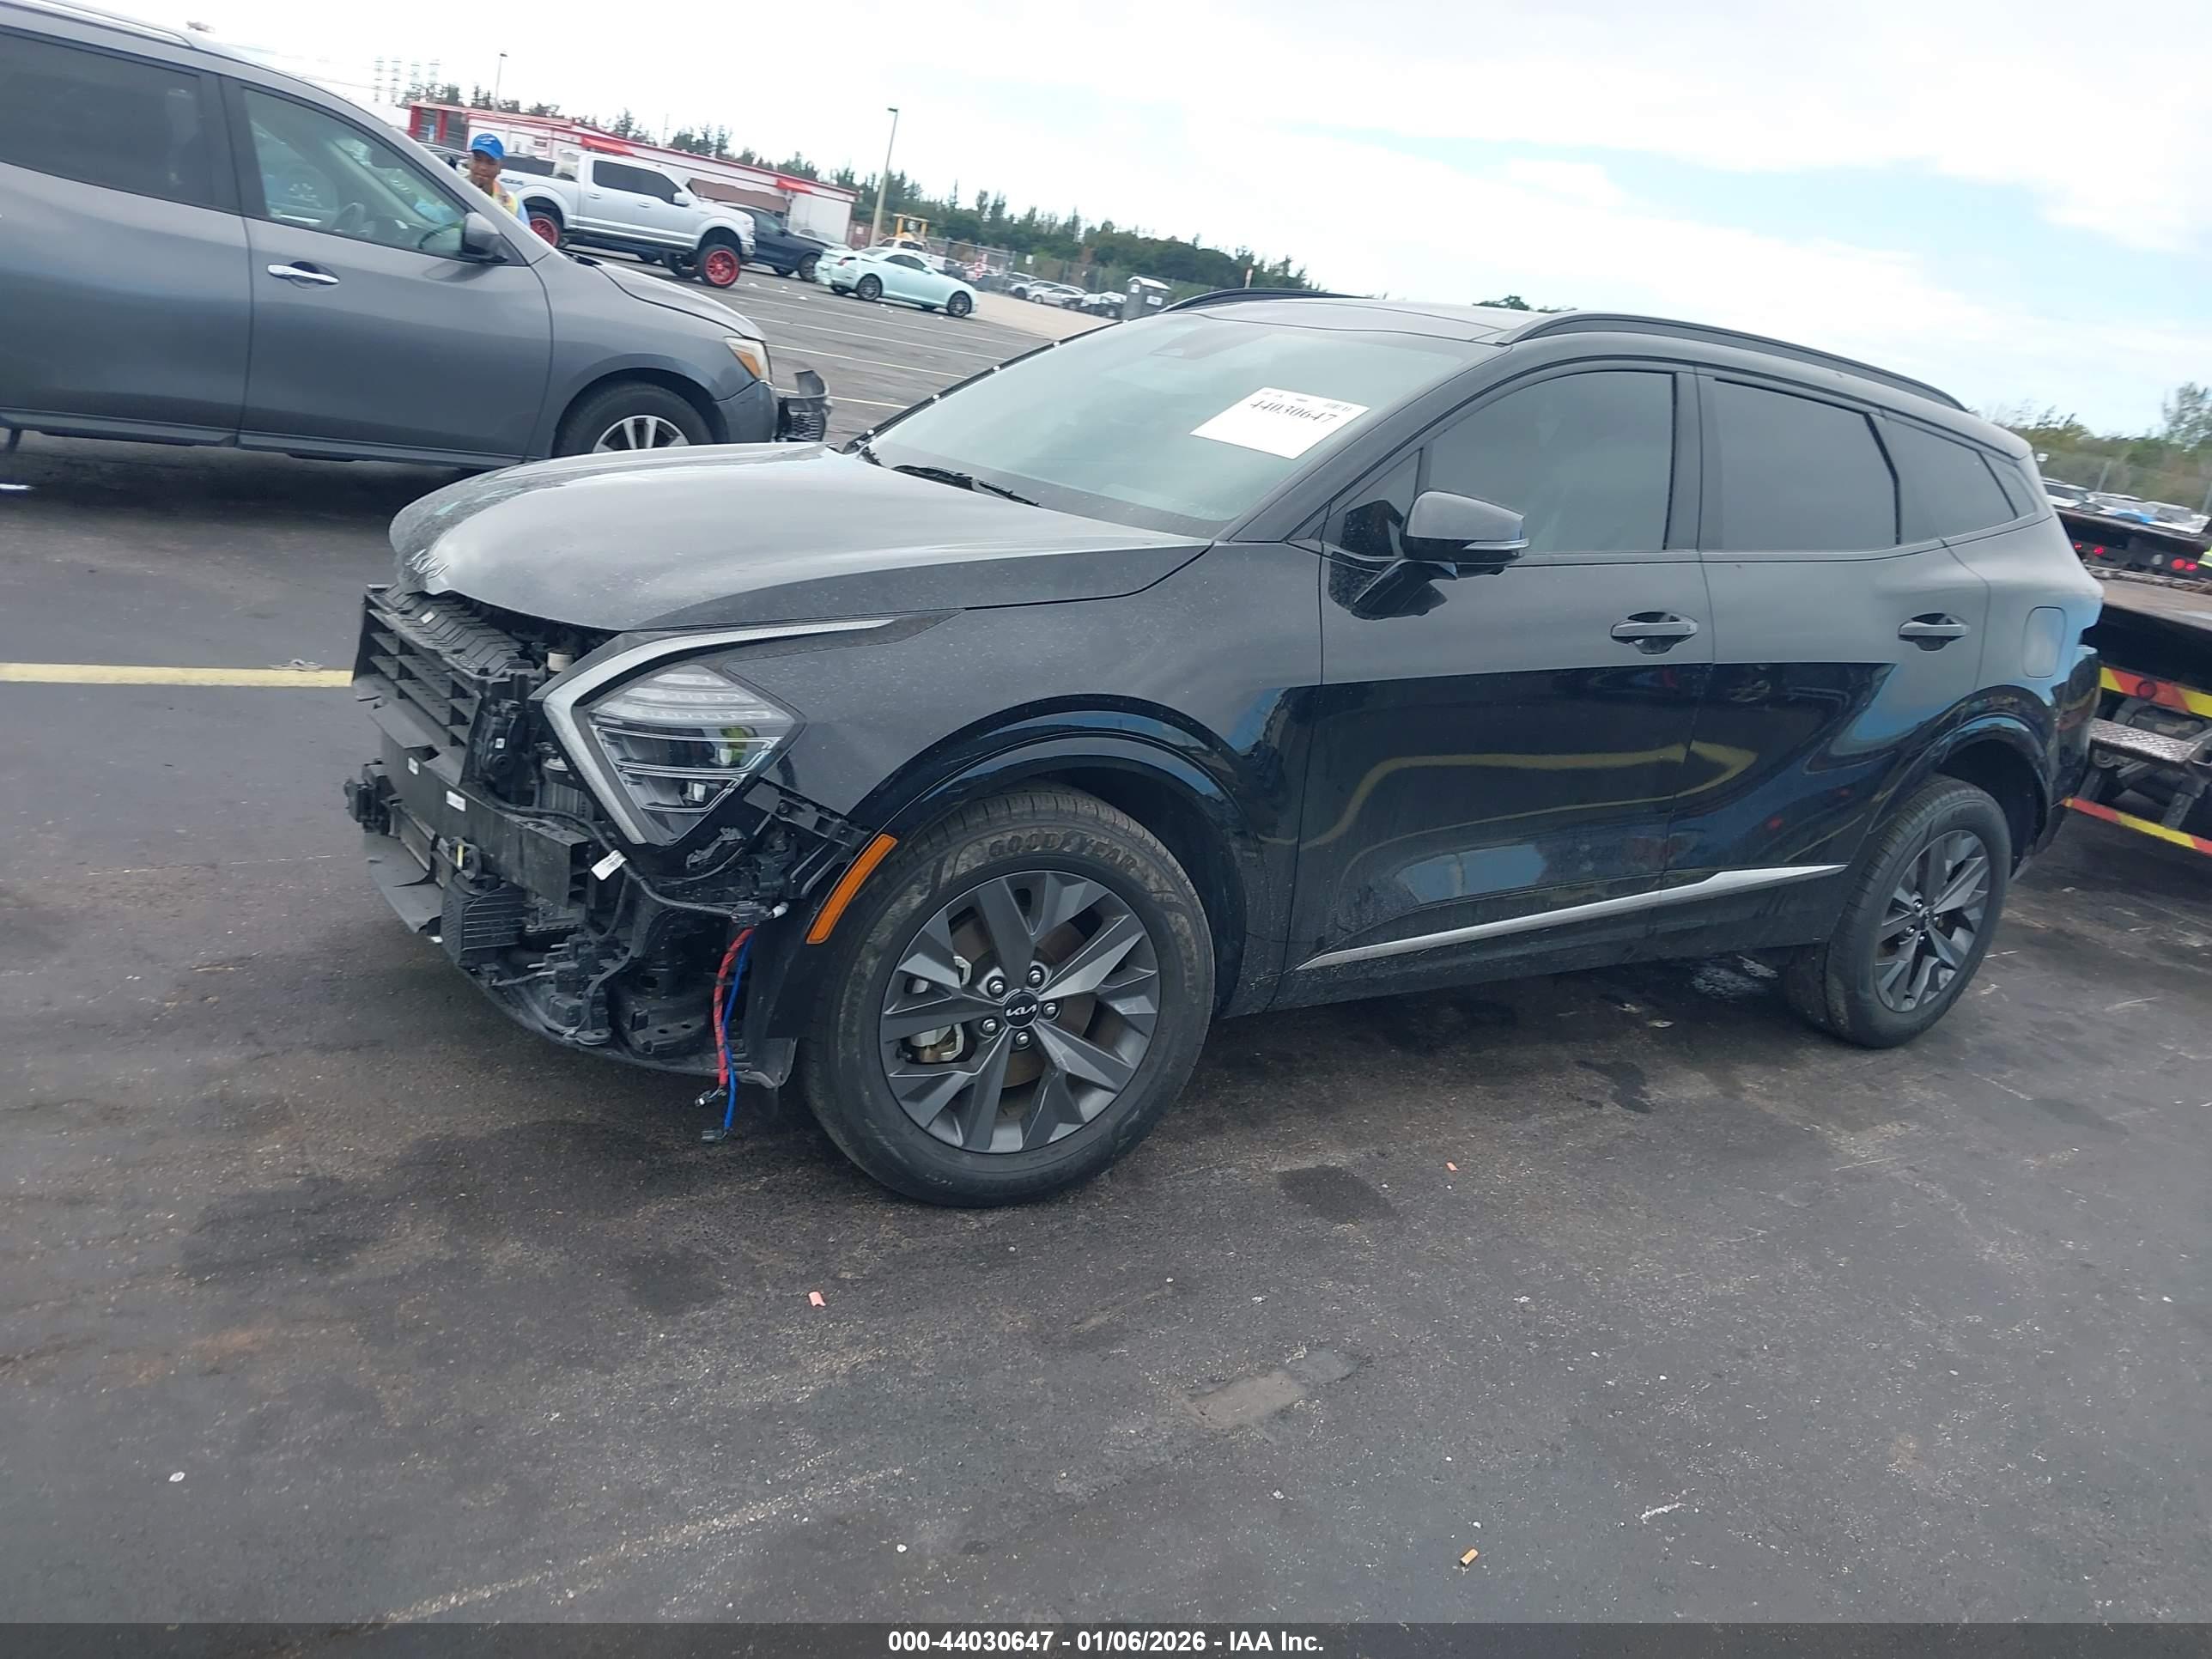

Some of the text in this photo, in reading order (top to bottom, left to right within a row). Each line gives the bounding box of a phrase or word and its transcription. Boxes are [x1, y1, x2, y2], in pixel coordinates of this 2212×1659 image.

[1249, 399, 1339, 423] 44030647
[988, 830, 1139, 872] GOODYEAR
[1006, 1003, 1037, 1017] KIA
